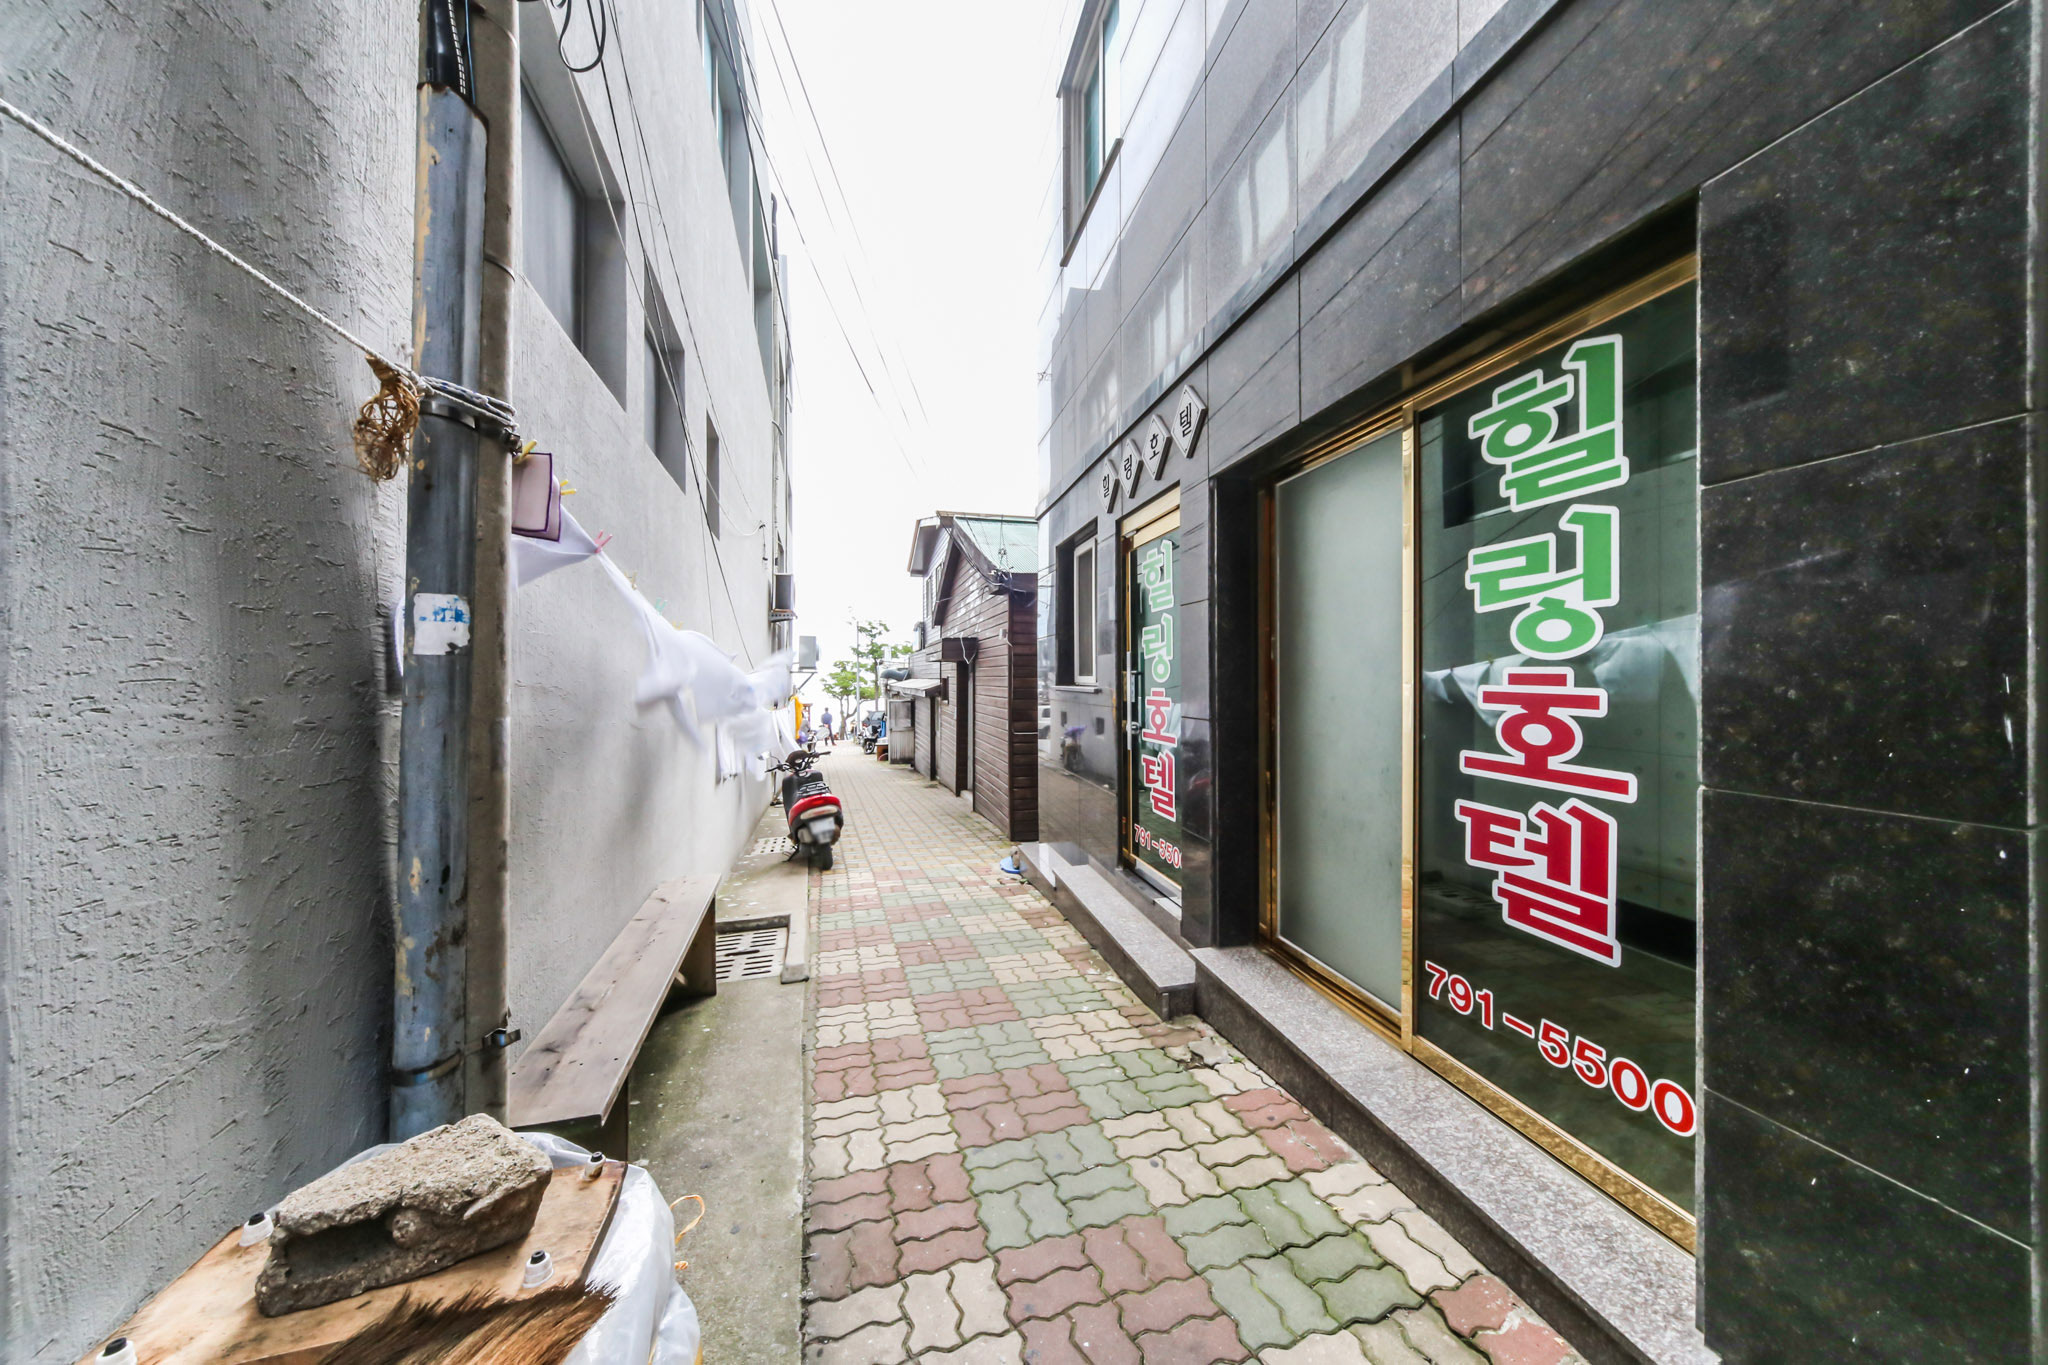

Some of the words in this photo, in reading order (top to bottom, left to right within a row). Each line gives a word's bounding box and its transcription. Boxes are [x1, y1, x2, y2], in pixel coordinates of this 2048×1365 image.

[1102, 402, 1192, 498] 힐링호텔
[1142, 539, 1177, 822] 힐링호텔
[1455, 334, 1638, 967] 힐링호텔
[1134, 823, 1182, 869] 791-550
[1425, 960, 1697, 1138] 791-5500
